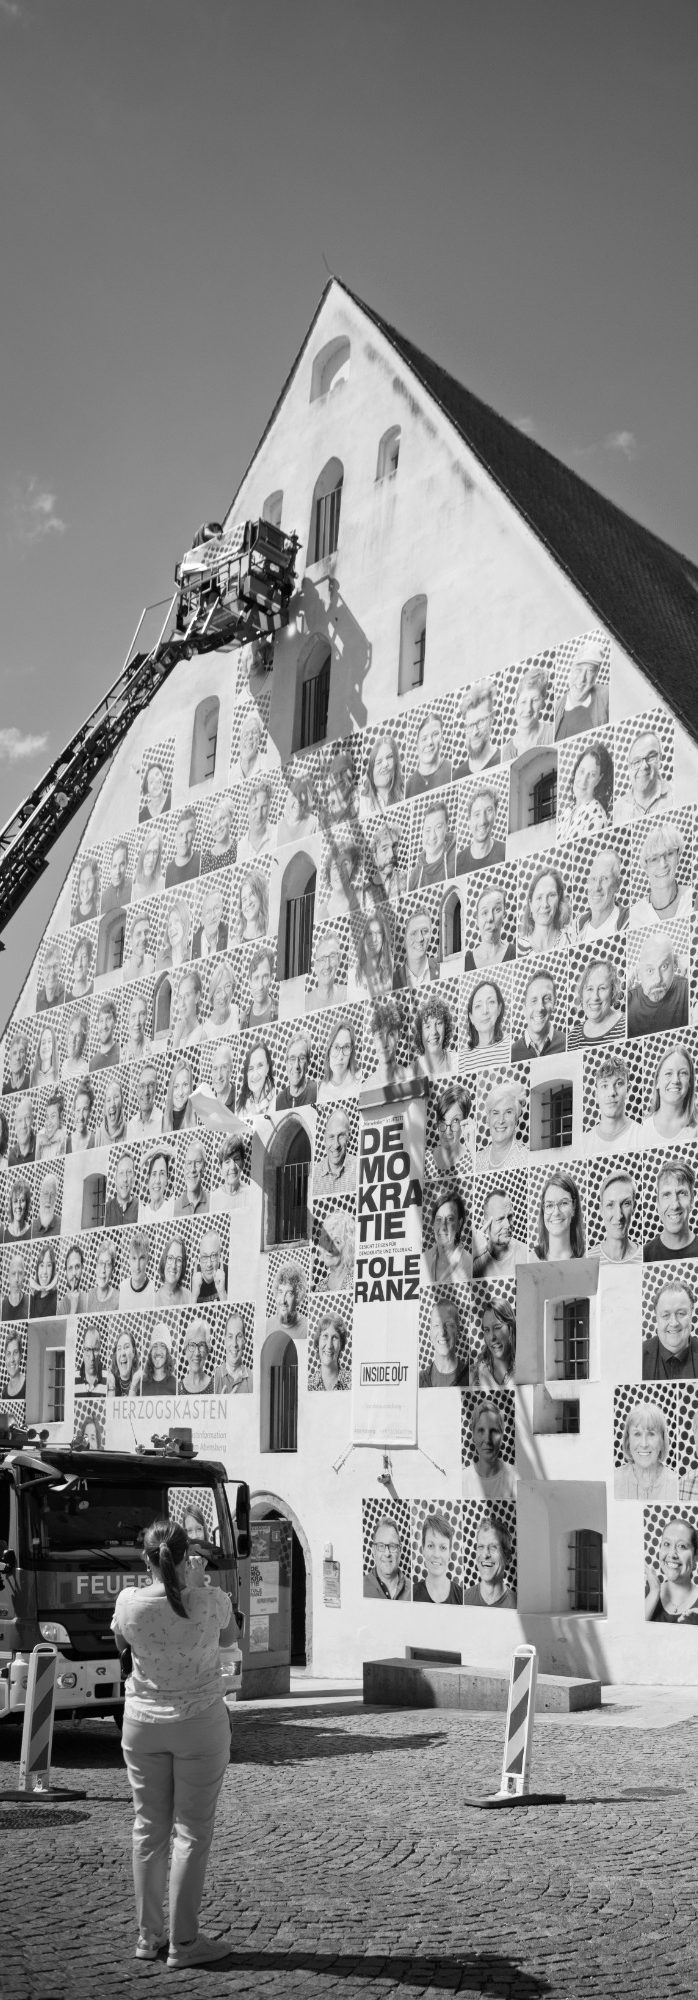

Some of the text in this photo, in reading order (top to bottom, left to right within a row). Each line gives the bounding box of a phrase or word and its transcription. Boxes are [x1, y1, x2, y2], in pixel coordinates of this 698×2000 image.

[360, 1122, 404, 1156] DE
[359, 1151, 411, 1185] MO
[358, 1179, 422, 1214] KRA
[357, 1210, 406, 1243] TIE
[356, 1253, 421, 1280] TOLE
[354, 1277, 420, 1304] RANZ
[362, 1365, 409, 1383] INSIDE OUT
[112, 1399, 228, 1420] HERZOGSKASTEN
